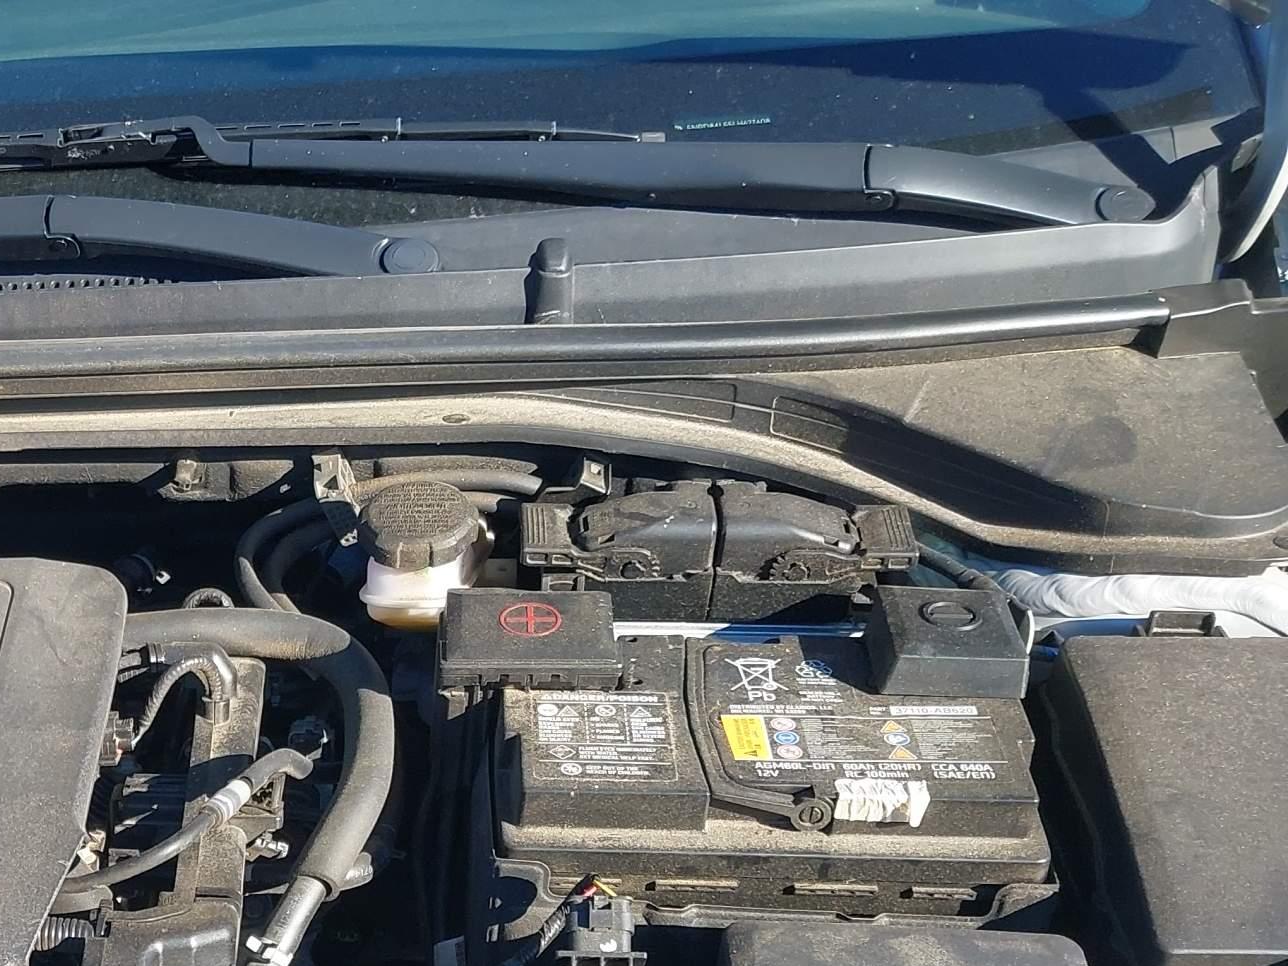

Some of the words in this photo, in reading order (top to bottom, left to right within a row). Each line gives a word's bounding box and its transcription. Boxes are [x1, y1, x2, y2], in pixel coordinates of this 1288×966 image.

[747, 690, 777, 701] Pb
[842, 763, 876, 771] 60Ah
[878, 763, 922, 771] (20HR)
[931, 764, 958, 772] CCA
[960, 764, 994, 772] 640A
[756, 769, 780, 777] 12V
[844, 770, 862, 778] RC
[865, 770, 910, 778] 100min
